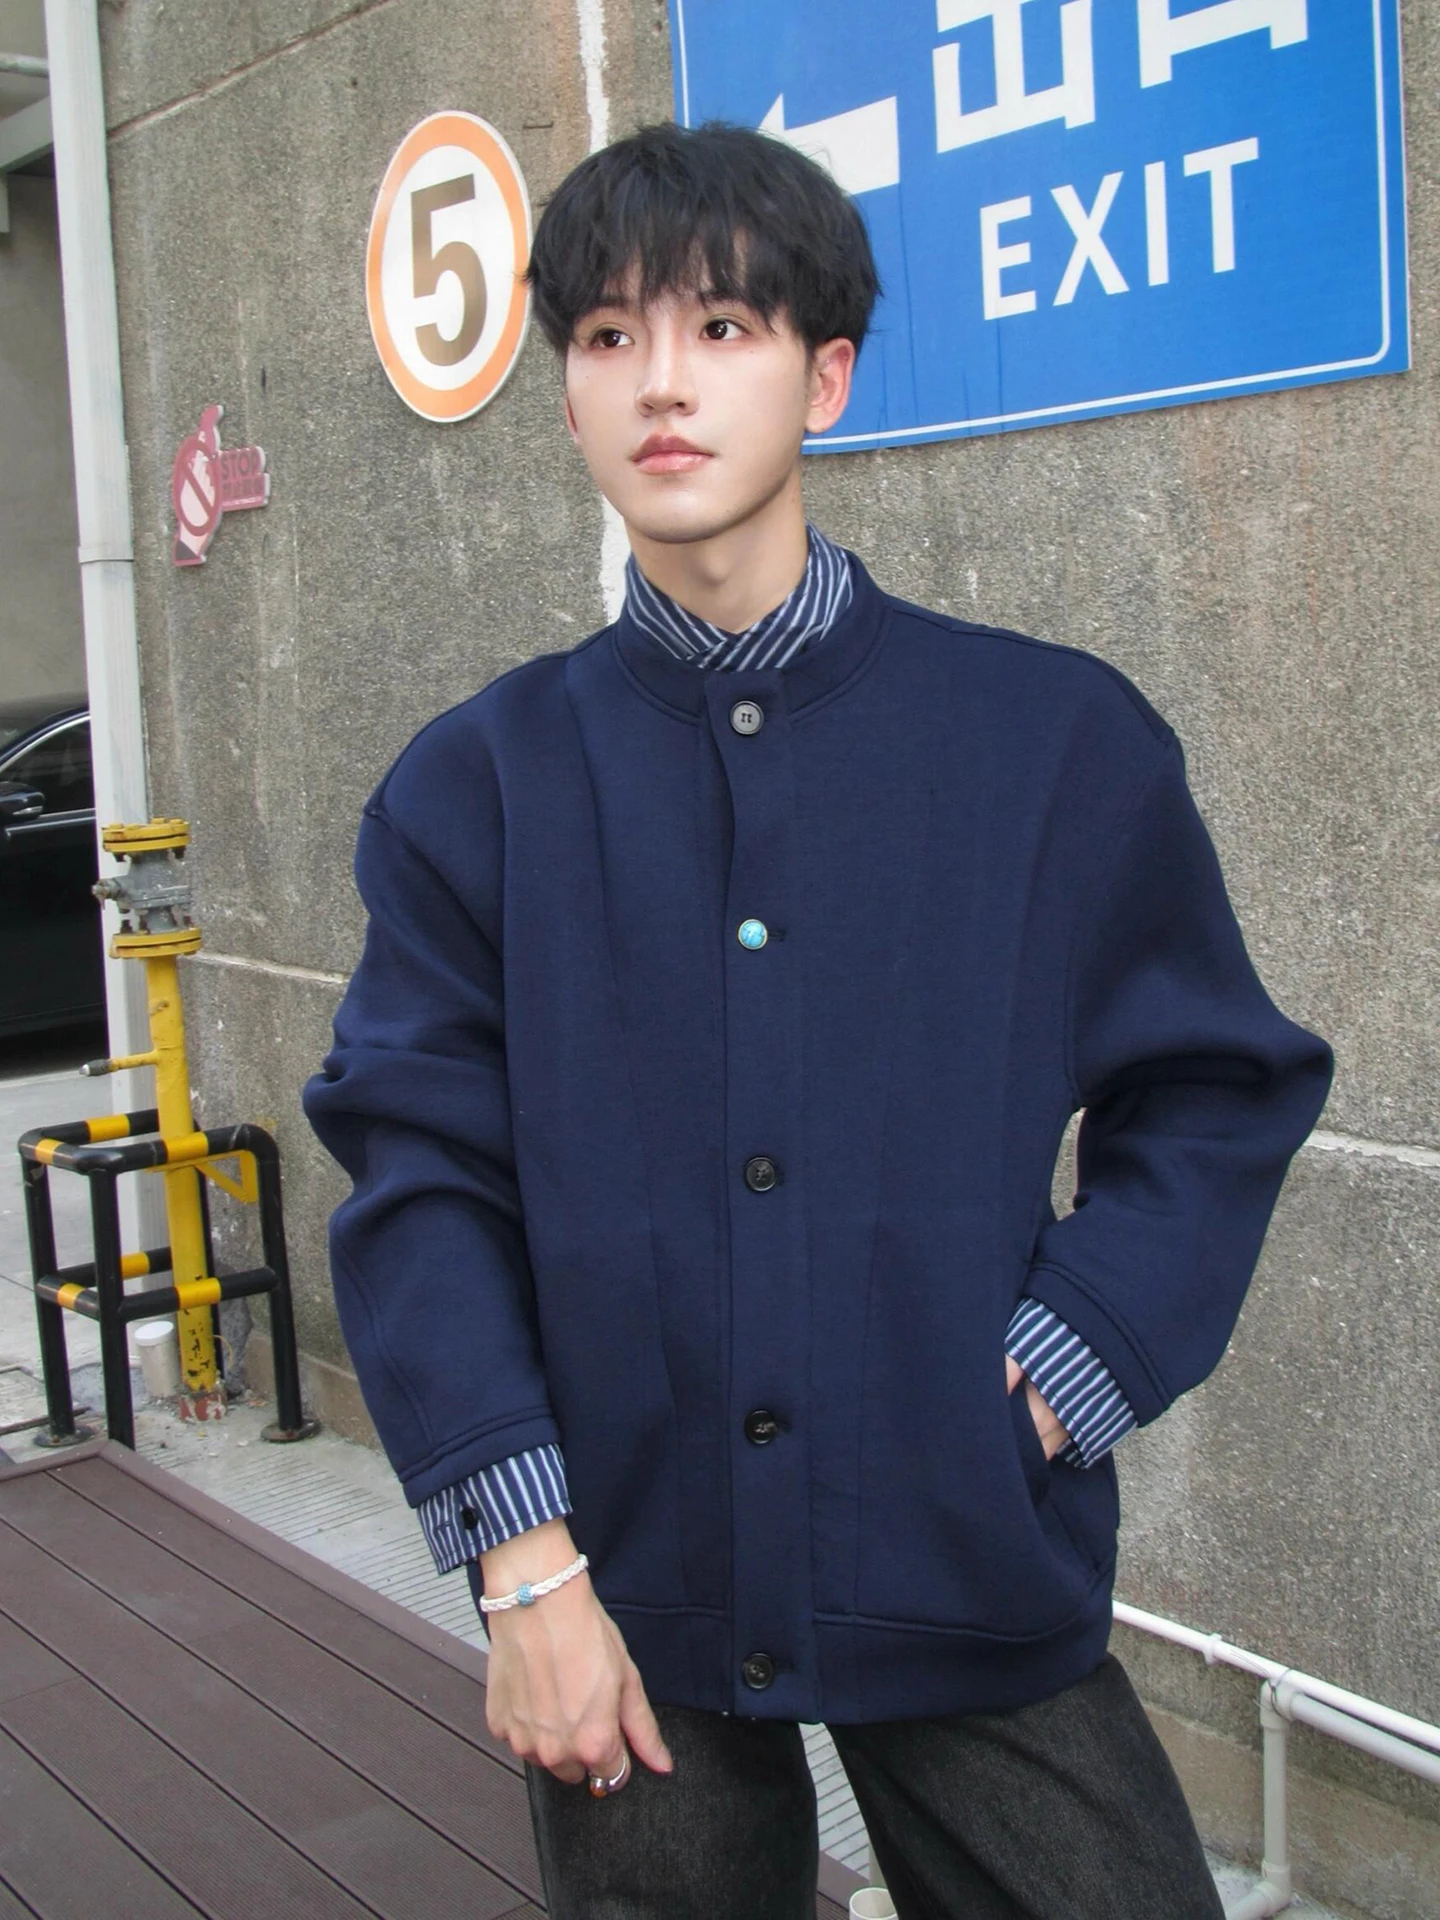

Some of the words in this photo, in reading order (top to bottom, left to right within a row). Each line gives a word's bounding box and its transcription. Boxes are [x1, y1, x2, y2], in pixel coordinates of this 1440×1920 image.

[410, 172, 488, 367] 5
[979, 137, 1260, 321] EXIT
[221, 449, 261, 480] STOP
